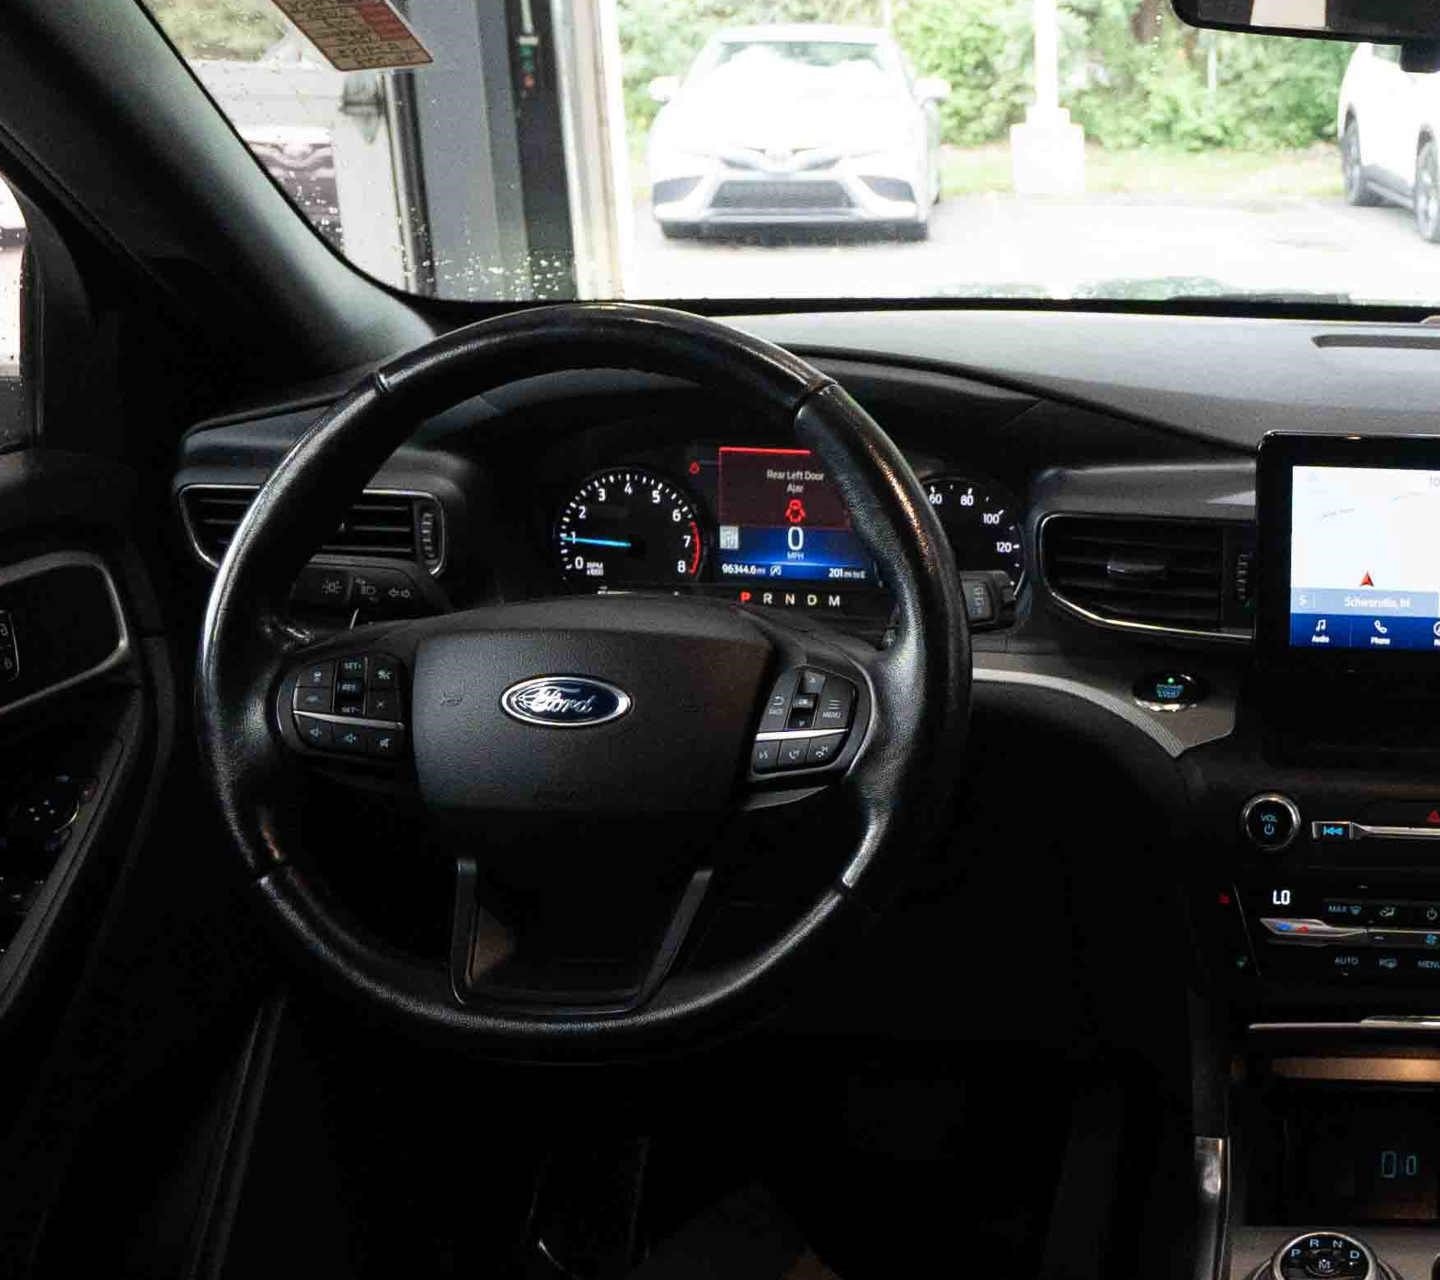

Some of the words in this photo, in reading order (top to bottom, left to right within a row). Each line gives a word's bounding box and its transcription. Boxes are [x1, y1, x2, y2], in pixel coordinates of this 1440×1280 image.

[767, 469, 785, 479] Rear
[787, 470, 803, 480] Left
[805, 470, 824, 481] Door
[598, 488, 606, 502] 3
[625, 482, 632, 496] 4
[786, 483, 804, 494] Ajar
[652, 490, 661, 504] 5
[928, 495, 942, 504] 60
[960, 495, 974, 506] 80
[578, 506, 586, 519] 2
[672, 508, 682, 522] 6
[983, 514, 1000, 524] 100
[570, 531, 576, 544] 1
[683, 535, 692, 548] 7
[788, 526, 804, 551] 0
[996, 542, 1012, 552] 120
[787, 552, 804, 560] MPH
[574, 556, 584, 570] 0
[677, 560, 686, 573] 8
[740, 592, 750, 602] P
[763, 592, 772, 604] R
[785, 594, 795, 605] N
[807, 594, 818, 605] D
[828, 595, 840, 606] M
[1371, 636, 1391, 645] Phone
[518, 684, 597, 713] Ford
[1260, 814, 1278, 822] VOL
[1272, 889, 1290, 905] LO
[1328, 904, 1348, 913] MAX
[1334, 956, 1359, 965] AUTO
[1290, 1249, 1302, 1257] P
[1310, 1239, 1320, 1248] R
[1332, 1240, 1343, 1248] N
[1350, 1250, 1360, 1259] D
[1318, 1260, 1330, 1270] M
